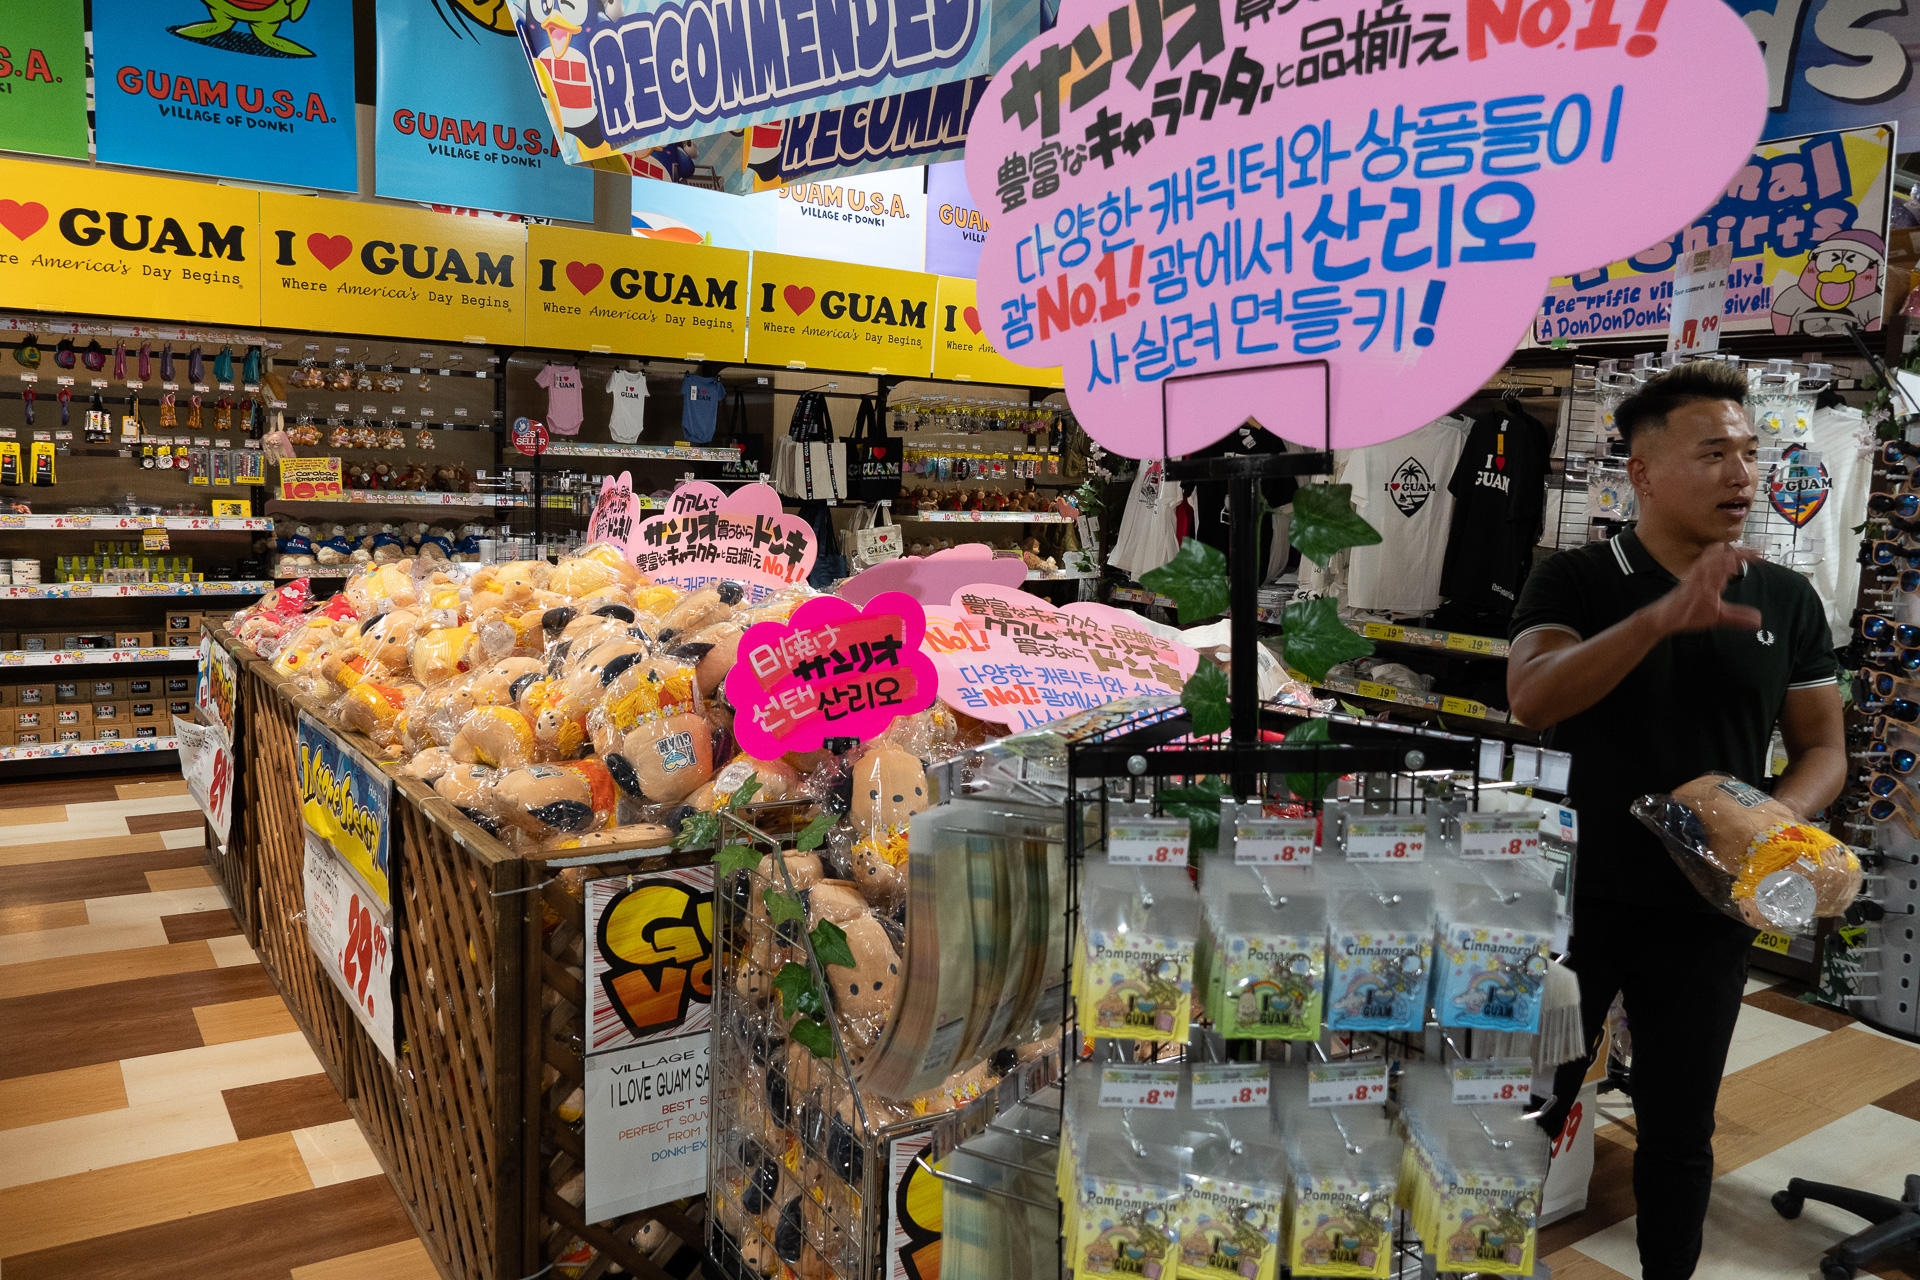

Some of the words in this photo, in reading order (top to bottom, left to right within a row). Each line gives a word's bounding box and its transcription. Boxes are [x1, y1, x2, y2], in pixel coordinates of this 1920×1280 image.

[1466, 0, 1668, 62] No.1!
[590, 0, 977, 136] RECOMMENDED
[117, 65, 228, 108] GUAM
[236, 84, 337, 123] U.S.A.
[159, 104, 221, 125] VILLAGE
[226, 115, 243, 128] OF
[247, 117, 294, 134] DONKI
[393, 108, 486, 147] GUAM
[428, 143, 480, 162] VILLAGE
[485, 154, 498, 164] OF
[502, 155, 541, 169] DONKI
[1016, 186, 1142, 284] 다양한
[1148, 119, 1351, 235] 캐릭터와
[1355, 85, 1624, 183] 상품들이
[847, 188, 910, 218] U.S.A.
[800, 206, 840, 222] VILLAGE
[842, 214, 853, 223] OF
[855, 215, 885, 227] DONKI
[59, 207, 245, 262] GUAM
[1301, 181, 1536, 282] 산리오
[275, 230, 297, 266] I
[361, 240, 515, 288] GUAM
[31, 253, 132, 276] America's
[142, 265, 172, 281] Day
[182, 268, 241, 286] Begins
[281, 277, 328, 292] Where
[337, 282, 420, 301] America's
[428, 291, 453, 306] Day
[461, 294, 510, 310] Begins
[539, 259, 557, 291] I
[610, 267, 738, 310] GUAM
[761, 283, 777, 313] I
[820, 290, 927, 329] GUAM
[543, 302, 581, 316] Where
[589, 306, 658, 322] America's
[665, 314, 686, 327] Day
[692, 316, 733, 330] Begins
[944, 305, 957, 332] I
[763, 322, 795, 334] Where
[801, 325, 859, 340] America's
[865, 333, 883, 345] Day
[888, 334, 922, 347] Begins
[1541, 318, 1553, 339] A
[946, 340, 974, 352] Where
[620, 391, 639, 399] GUAM
[516, 437, 546, 446] SELLR
[862, 462, 900, 475] GUAM
[1484, 453, 1492, 470] I
[284, 482, 342, 499] 10.99
[1401, 482, 1436, 493] GUAM
[1785, 477, 1833, 491] GUAM
[750, 624, 840, 679] 日焼け
[792, 634, 903, 682] サンリオ
[959, 664, 1034, 685] 다양한
[817, 677, 903, 721] 산리오
[656, 732, 693, 755] GUAM
[1148, 846, 1184, 863] $8.99
[1273, 845, 1310, 862] $8.99
[1386, 842, 1422, 858] $8.99
[1501, 838, 1538, 856] $8.99
[1757, 932, 1788, 948] $20.99
[1125, 1013, 1155, 1026] GUAM
[1260, 1012, 1289, 1026] GUAM
[1363, 1005, 1392, 1018] GUAM
[1484, 1004, 1513, 1018] GUAM
[611, 1048, 694, 1076] VILLAGE
[610, 1083, 615, 1109] I
[619, 1076, 651, 1107] LOVE
[656, 1067, 691, 1097] GUAM
[1139, 1089, 1175, 1105] $8.99
[1232, 1087, 1267, 1103] $8.99
[1348, 1084, 1383, 1100] $8.99
[1493, 1083, 1529, 1100] $8.99
[662, 1099, 694, 1115] BEST
[618, 1118, 674, 1141] PERFECT
[668, 1127, 701, 1144] FROM
[1448, 1182, 1534, 1199] Pompompurin
[1330, 1250, 1358, 1263] GUAM
[1476, 1246, 1504, 1260] GUAM
[1113, 1261, 1143, 1274] GUAM
[1209, 1255, 1239, 1271] GUAM
